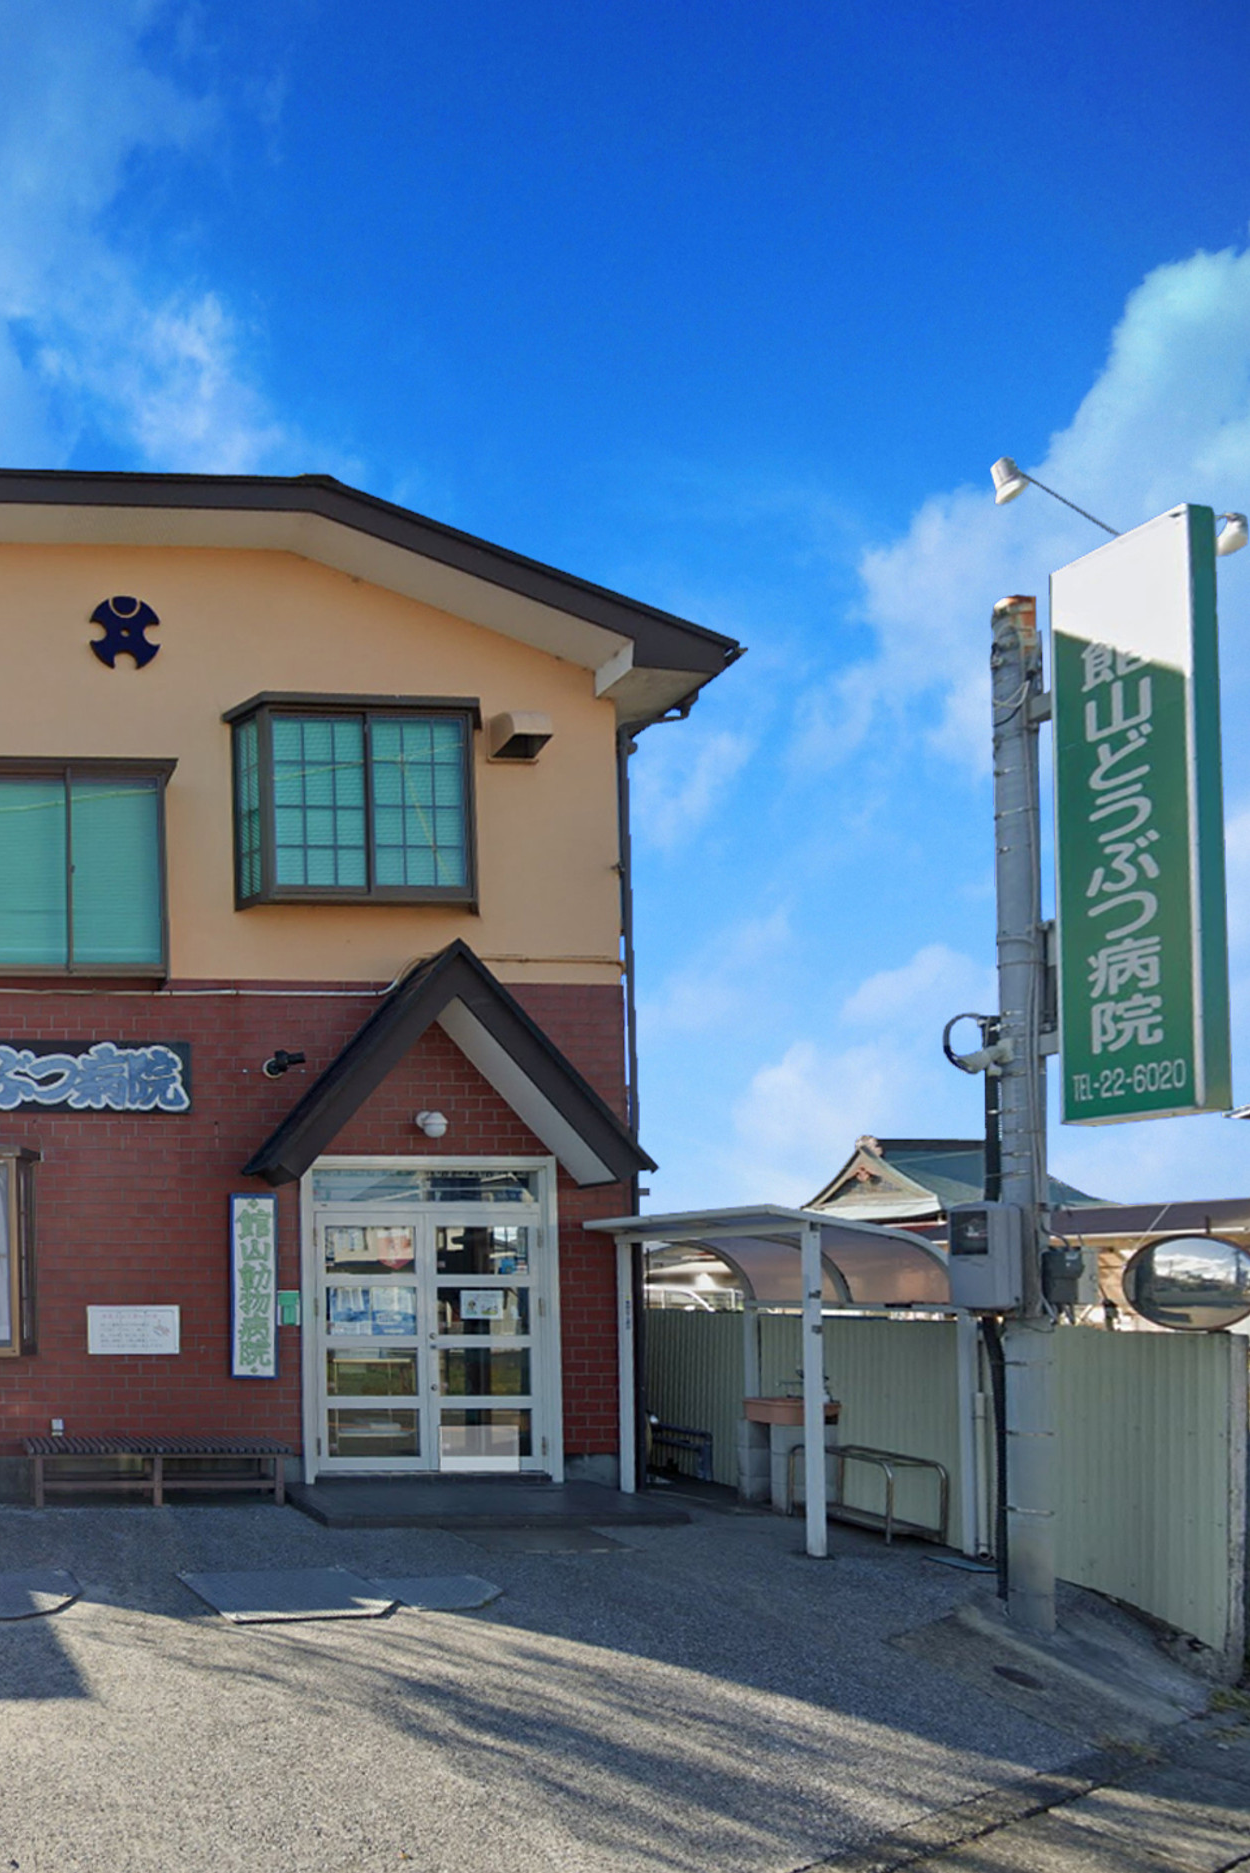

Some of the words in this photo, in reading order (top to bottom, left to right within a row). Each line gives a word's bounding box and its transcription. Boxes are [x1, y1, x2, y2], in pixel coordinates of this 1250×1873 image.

[236, 1209, 272, 1366] 館山動物病院
